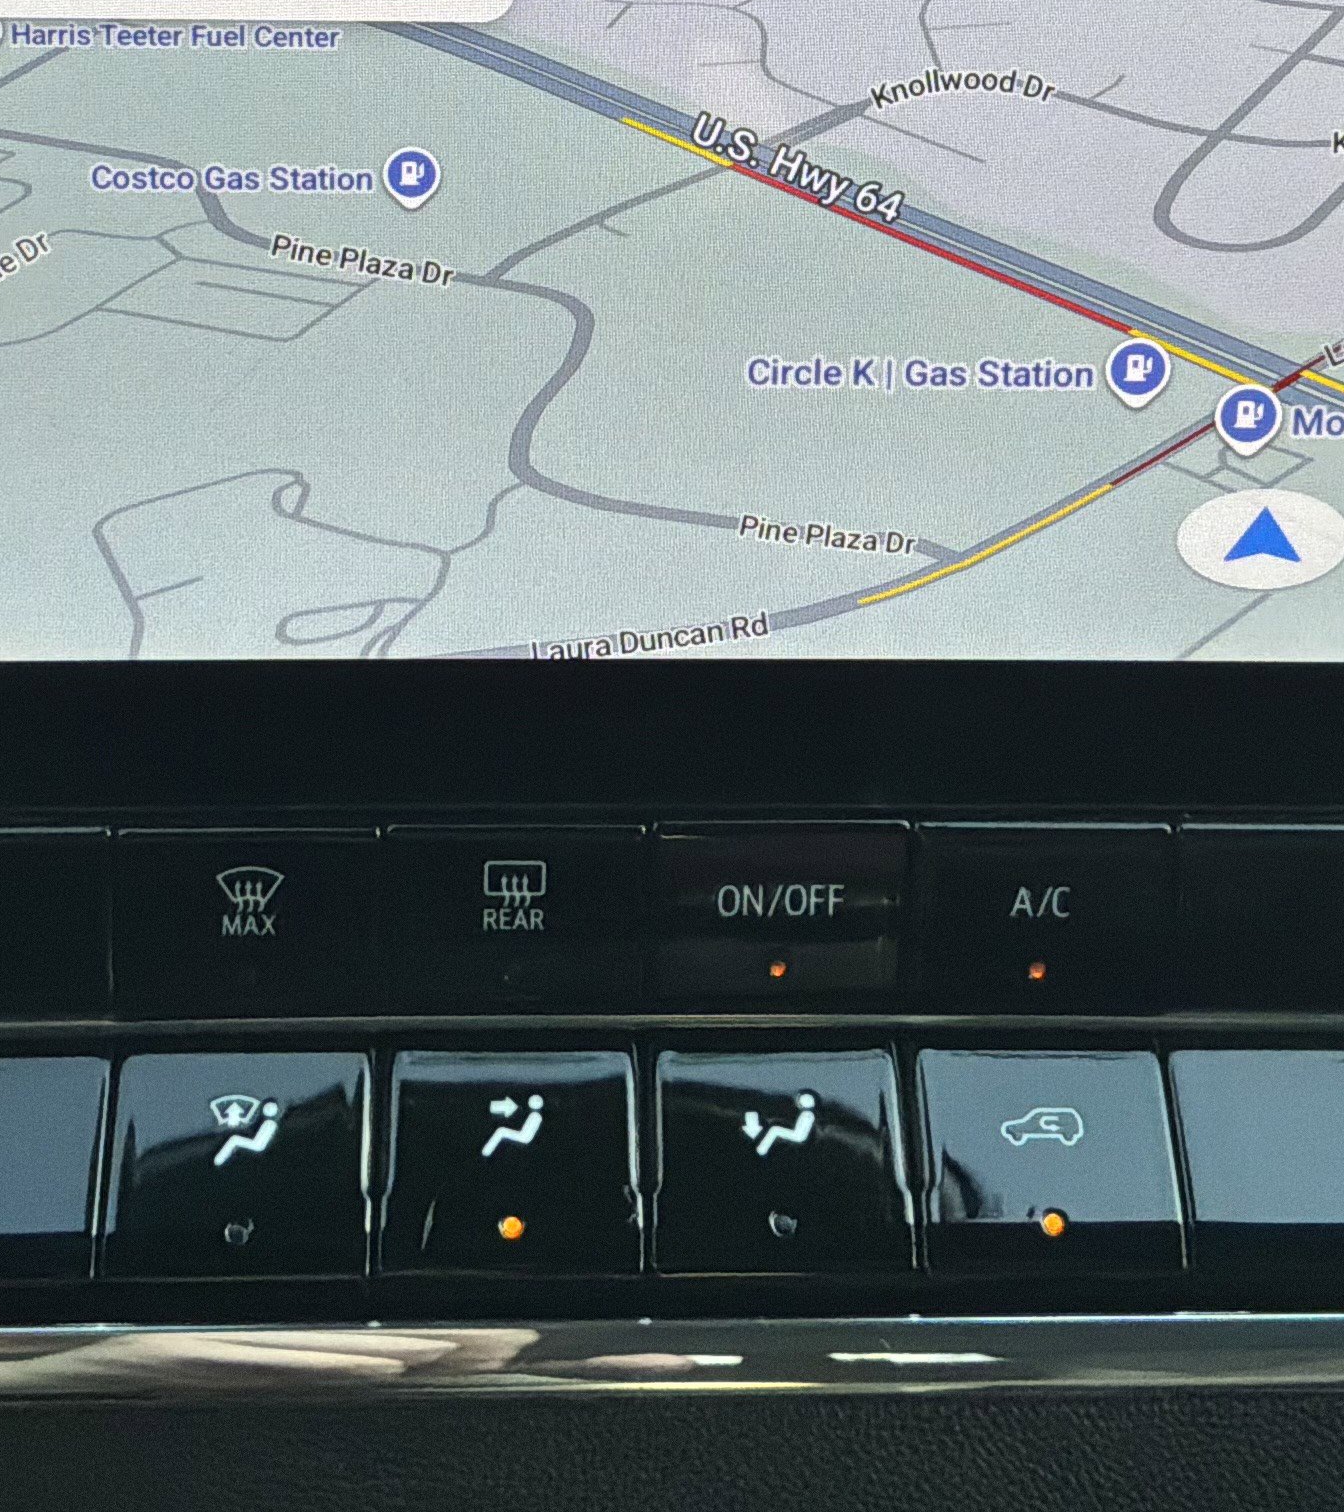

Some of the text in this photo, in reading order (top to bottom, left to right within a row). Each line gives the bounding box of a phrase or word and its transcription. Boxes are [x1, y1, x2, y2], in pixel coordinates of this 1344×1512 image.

[10, 24, 340, 49] Harris Teeter Fuel Center
[870, 71, 1056, 109] Knollwood Dr
[91, 165, 373, 193] Costco Gas Station
[692, 113, 903, 223] U.S. Hwy 64
[14, 232, 51, 265] Dr
[270, 235, 454, 286] Pine Plaza Dr
[747, 356, 842, 388] Circle
[854, 358, 877, 387] K
[904, 359, 967, 389] Gas
[978, 358, 1094, 390] Station
[739, 515, 916, 555] Pine Plaza Dr
[532, 612, 769, 661] Laura Duncan Rd
[717, 884, 846, 919] ON/OFF
[1010, 886, 1071, 918] A/C
[221, 914, 277, 936] MAX
[483, 908, 545, 931] REAR
